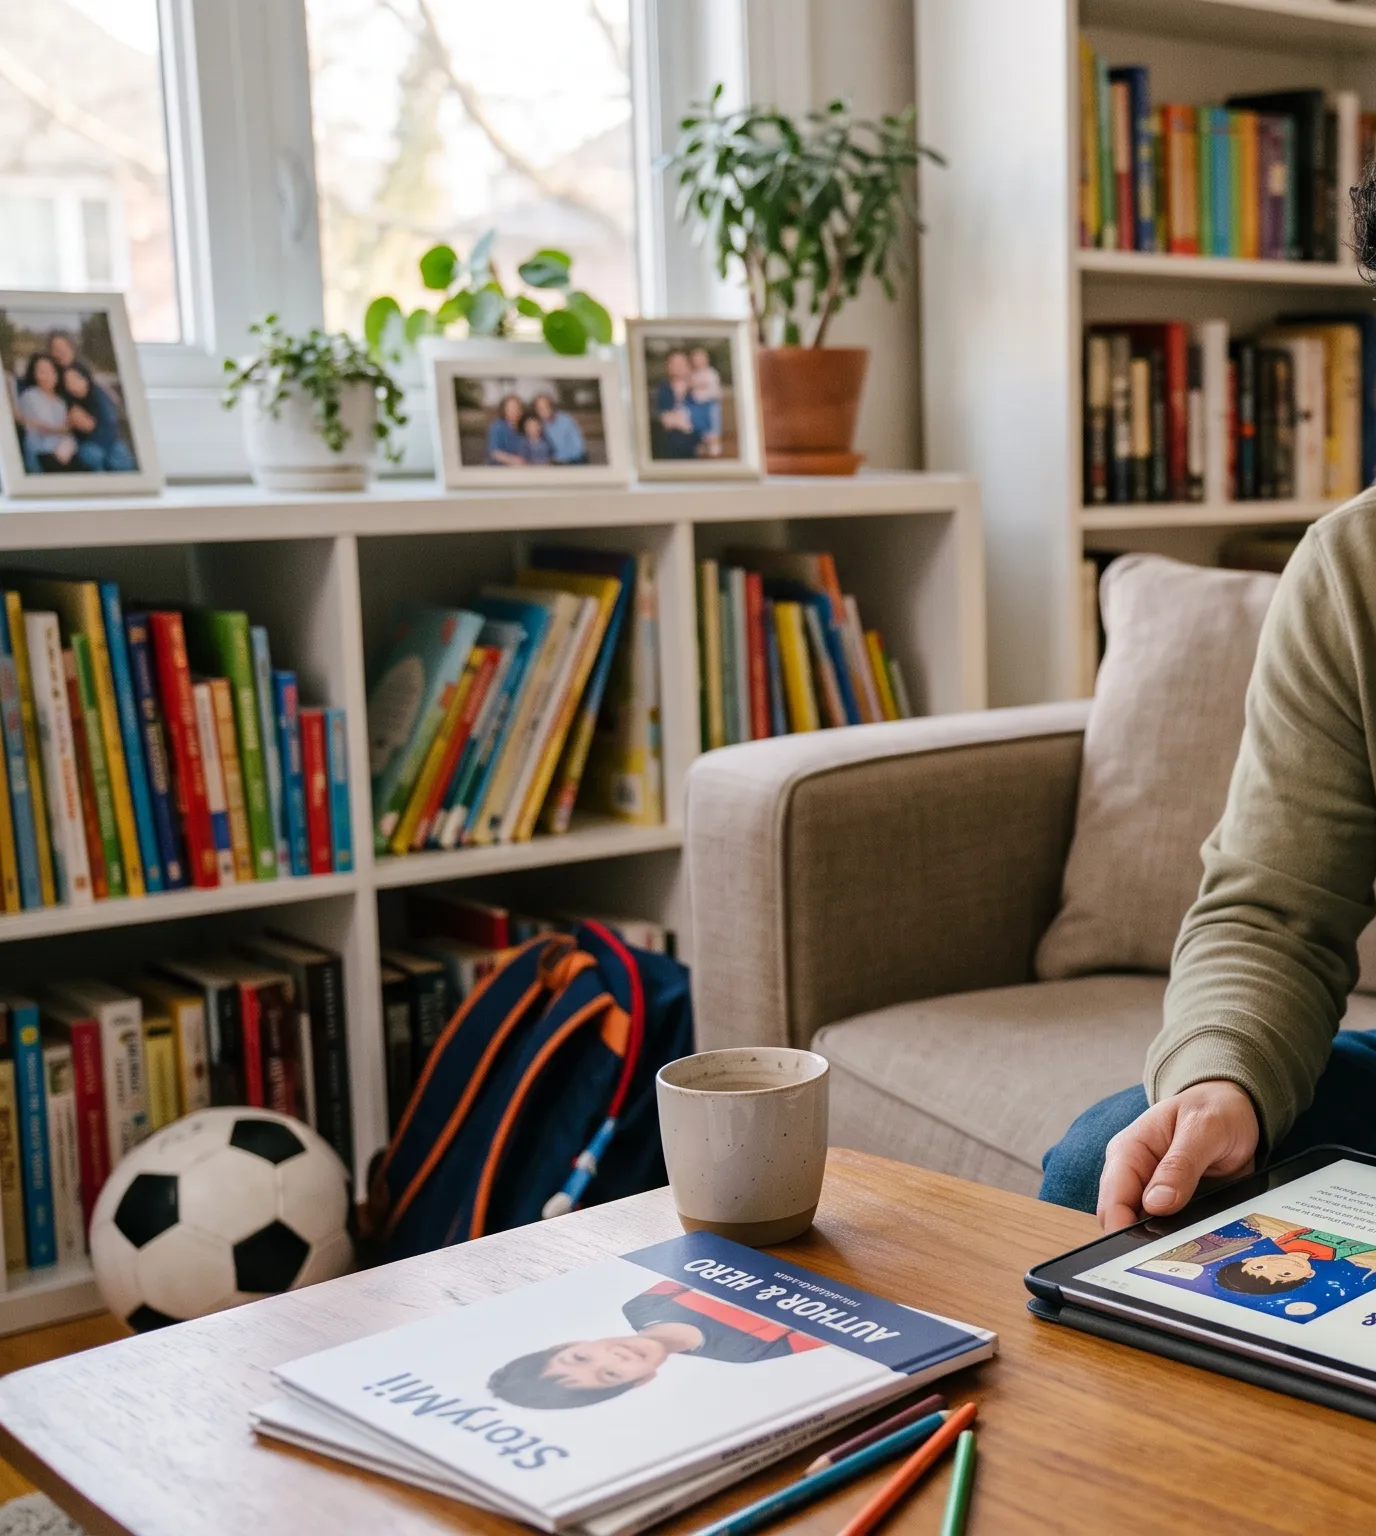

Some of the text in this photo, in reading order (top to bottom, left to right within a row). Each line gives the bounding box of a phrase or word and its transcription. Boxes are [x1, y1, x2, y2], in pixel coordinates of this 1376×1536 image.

[683, 1258, 765, 1291] HERO
[755, 1285, 787, 1300] &
[776, 1293, 901, 1343] AUTHOR
[362, 1372, 570, 1470] StoryMii
